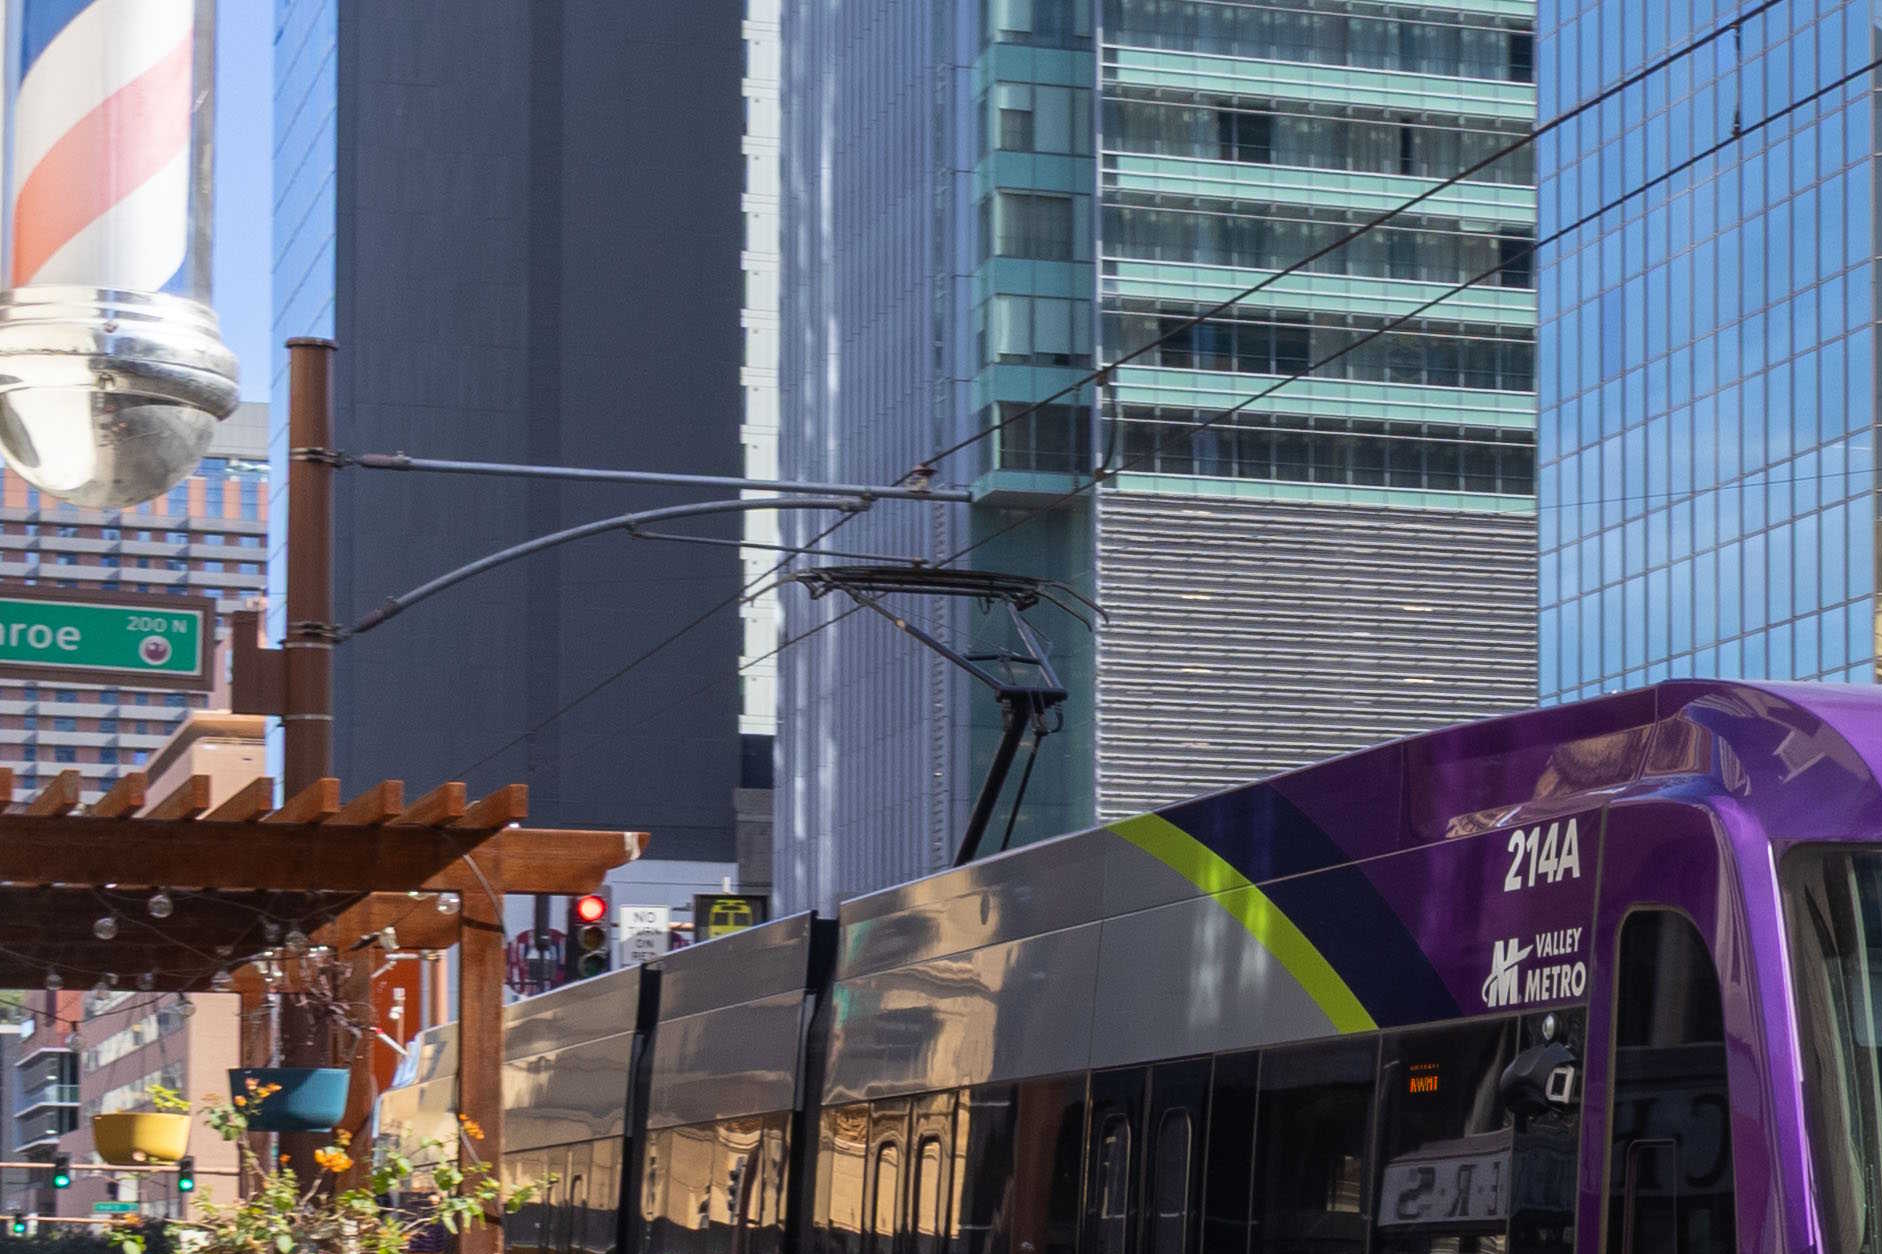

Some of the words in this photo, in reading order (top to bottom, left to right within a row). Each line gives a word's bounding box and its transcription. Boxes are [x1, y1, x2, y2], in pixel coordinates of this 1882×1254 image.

[0, 622, 82, 651] roe
[126, 615, 168, 633] 200
[171, 619, 188, 634] N
[1503, 817, 1581, 892] 214A
[632, 911, 656, 923] NO
[635, 938, 655, 949] ON
[1535, 926, 1583, 958] VALLEY
[1524, 960, 1587, 1004] METRO
